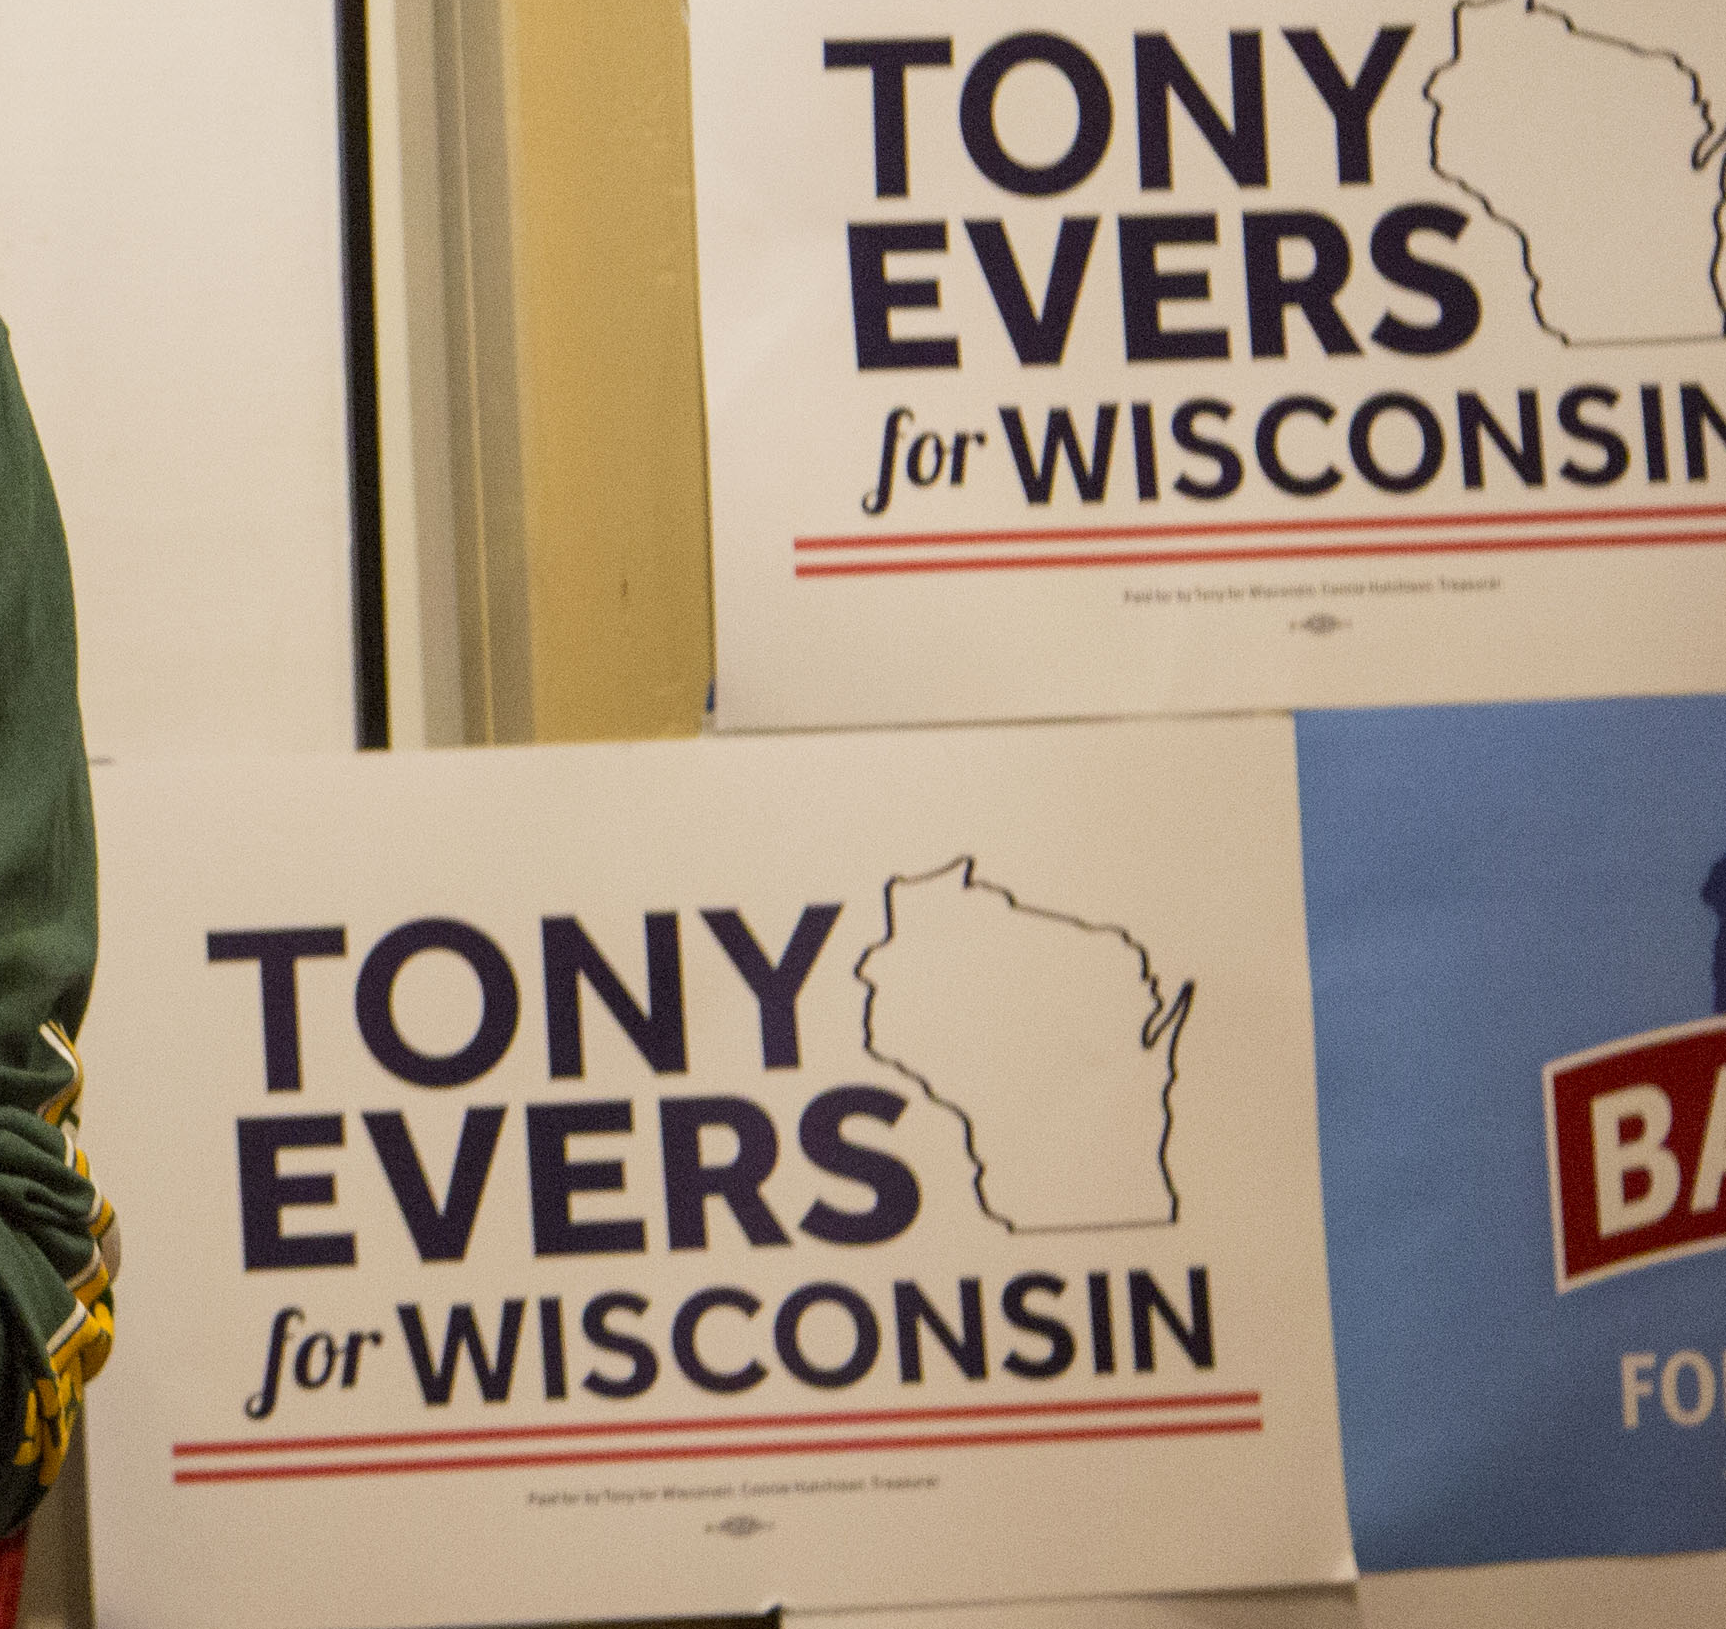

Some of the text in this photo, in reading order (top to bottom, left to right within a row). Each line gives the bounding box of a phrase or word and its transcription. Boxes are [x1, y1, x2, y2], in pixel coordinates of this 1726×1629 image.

[823, 25, 1417, 199] TONY
[847, 202, 1484, 371] EVERS
[861, 407, 987, 516] for
[206, 903, 844, 1094] TONY
[236, 1085, 923, 1271] EVERS
[245, 1306, 383, 1419] for
[397, 1266, 1216, 1407] WISCONSIN
[1621, 1348, 1726, 1430] FO
